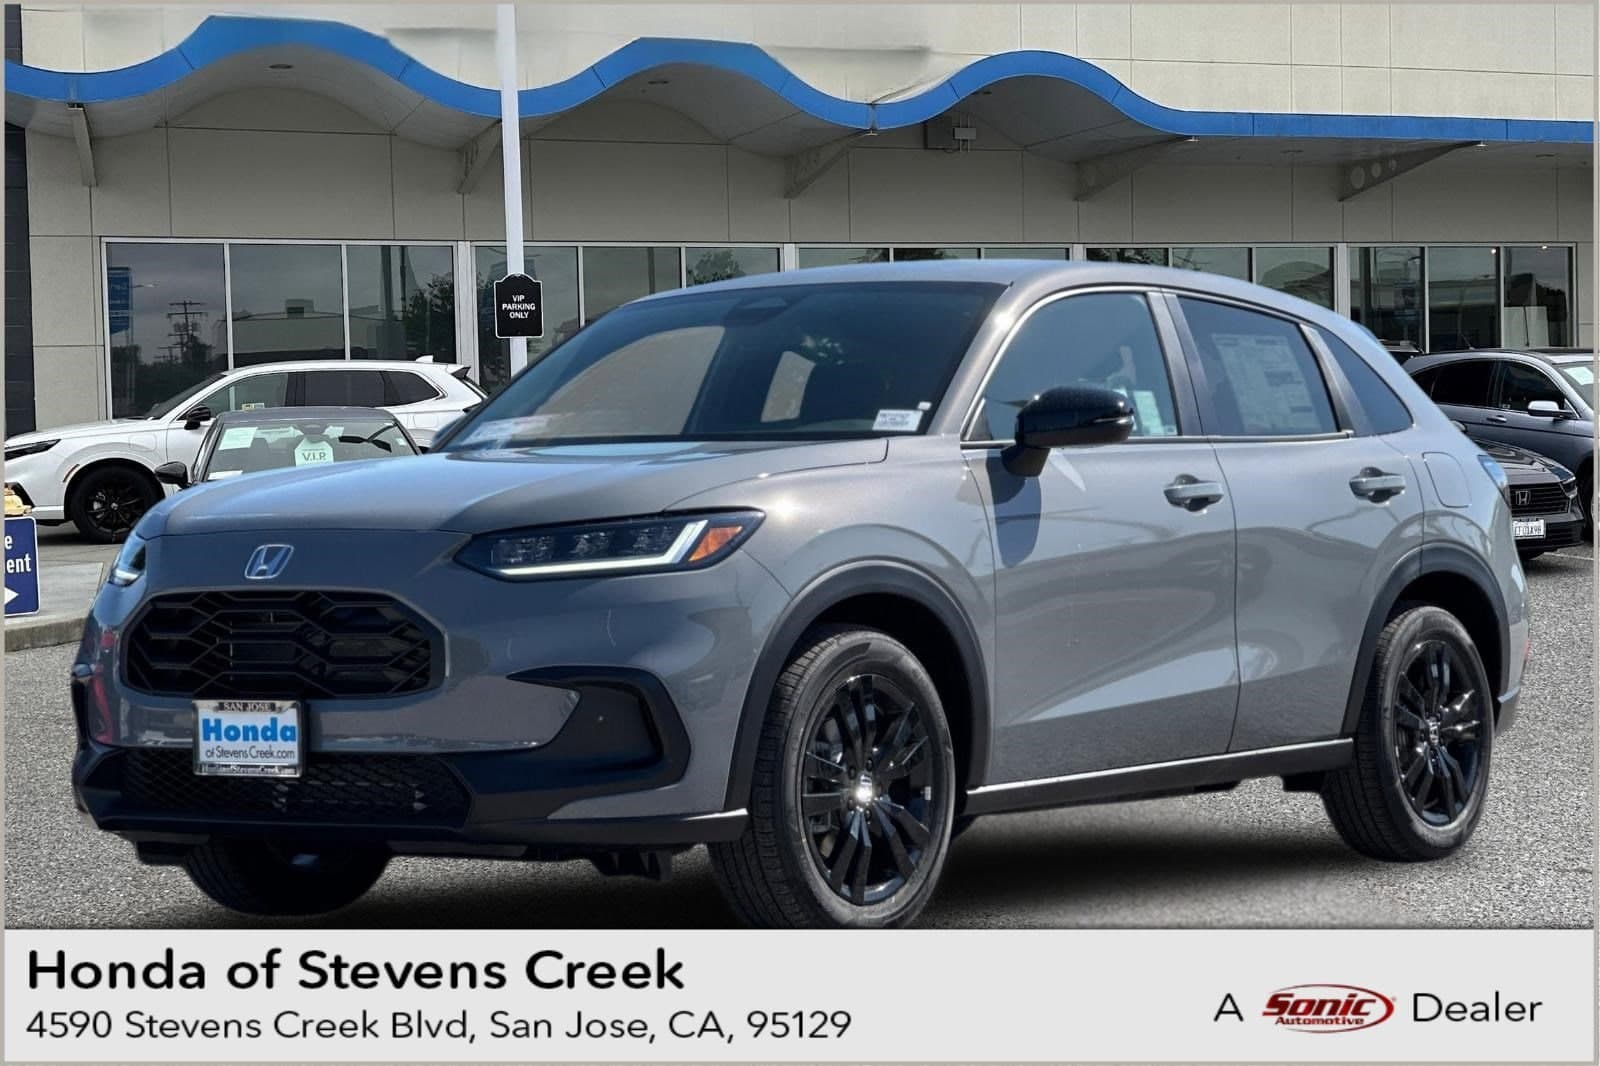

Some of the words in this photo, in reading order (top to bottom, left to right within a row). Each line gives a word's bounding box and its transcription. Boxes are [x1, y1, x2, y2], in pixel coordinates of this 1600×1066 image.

[509, 311, 529, 319] ONLY
[223, 702, 244, 711] SAN
[246, 702, 271, 712] JOSE
[202, 716, 297, 742] Honda
[205, 747, 214, 758] of
